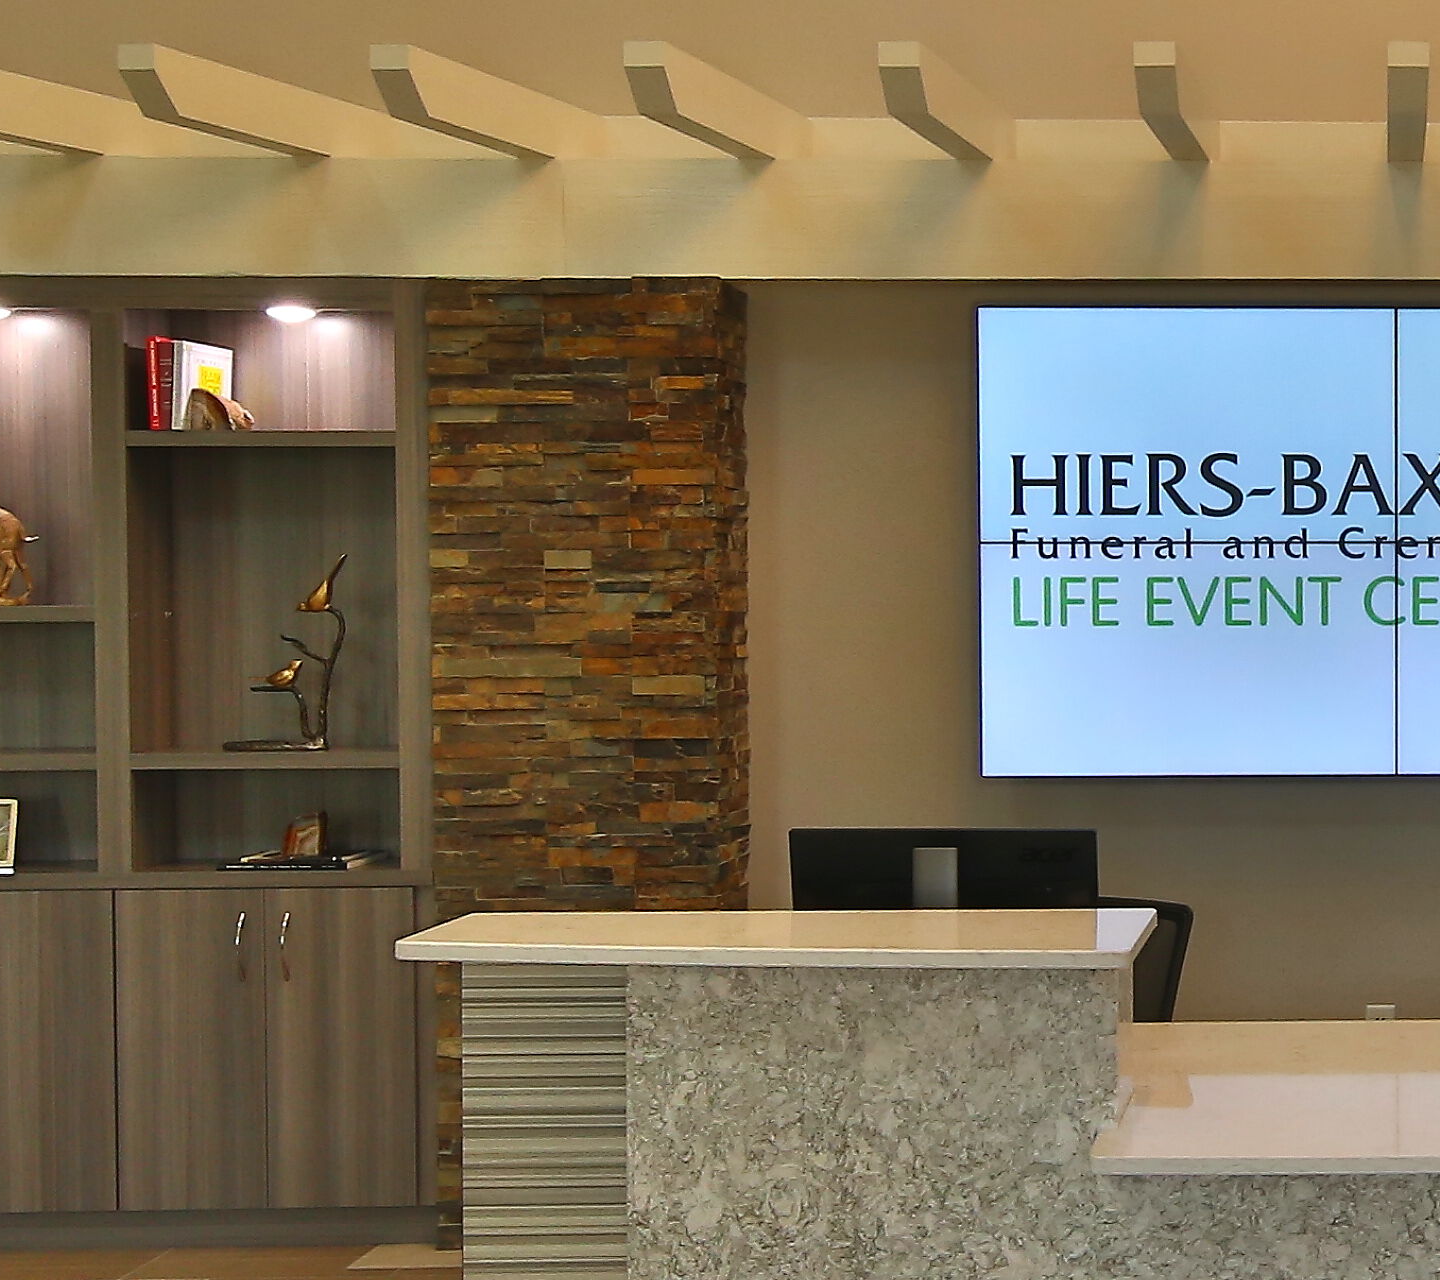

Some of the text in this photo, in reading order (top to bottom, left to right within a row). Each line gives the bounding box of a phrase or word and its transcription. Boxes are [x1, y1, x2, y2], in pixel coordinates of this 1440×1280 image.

[1010, 526, 1192, 559] Funeral
[1222, 526, 1308, 559] and
[1012, 576, 1120, 626] LIFE
[1146, 576, 1342, 626] EVENT
